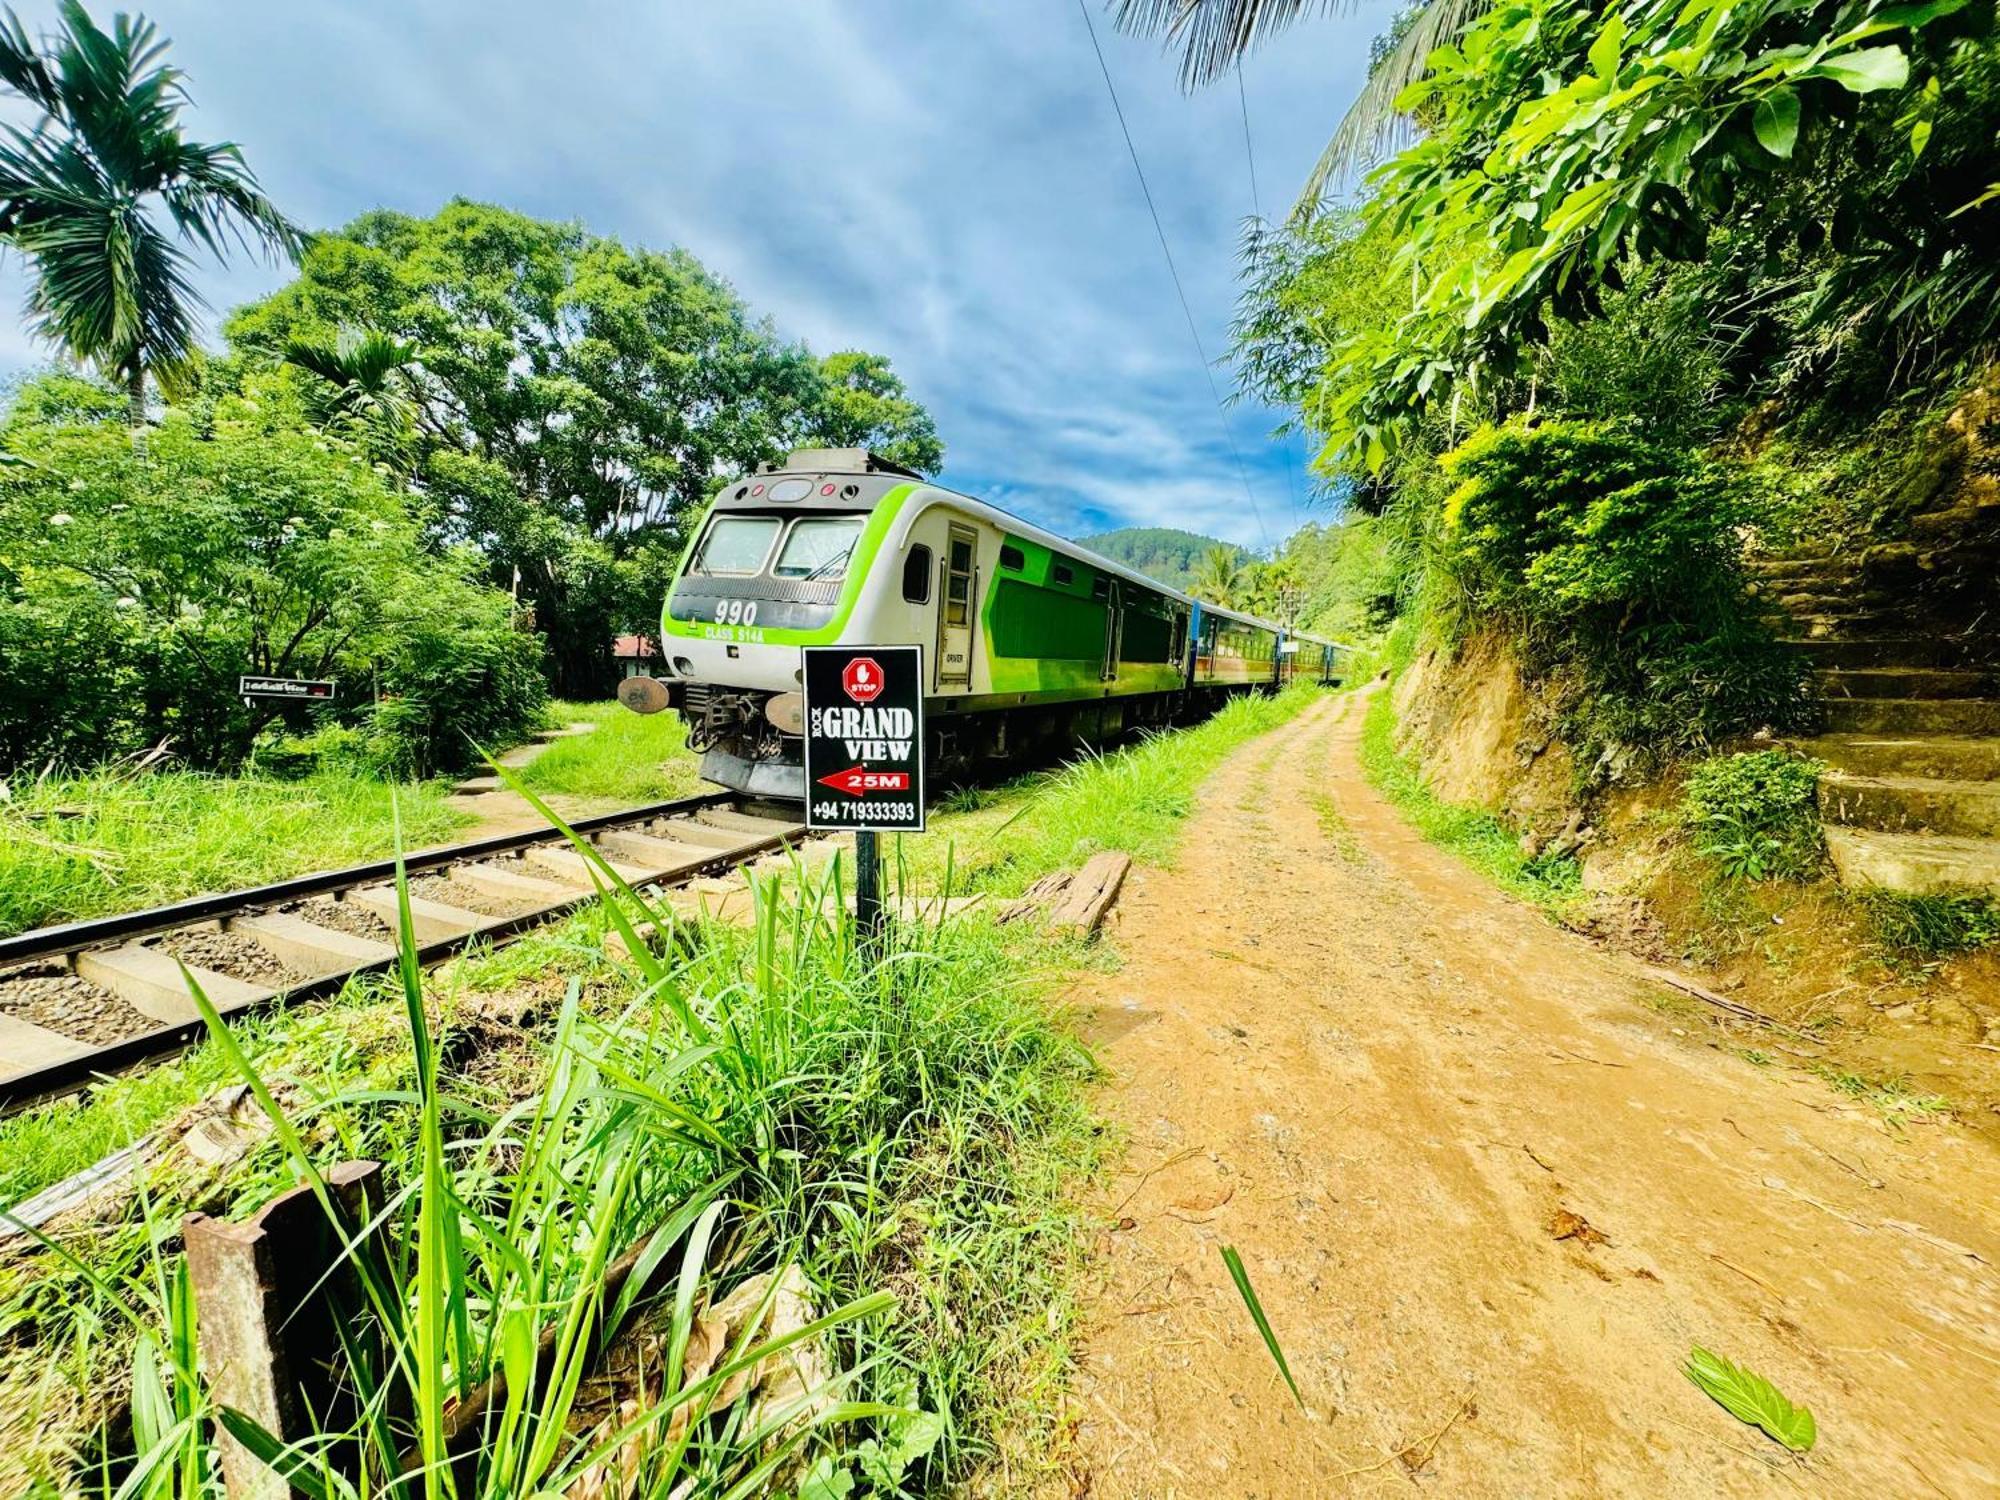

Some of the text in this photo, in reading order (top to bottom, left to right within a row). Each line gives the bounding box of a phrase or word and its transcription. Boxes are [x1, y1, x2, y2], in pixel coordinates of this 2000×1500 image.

[715, 600, 757, 626] 990
[705, 627, 764, 642] CLASS S14A
[851, 684, 876, 692] STOP
[811, 707, 822, 737] ROCK
[822, 707, 913, 739] GRAND
[844, 740, 913, 761] VIEW
[848, 775, 901, 788] 25M
[813, 801, 914, 820] +94 719333393
